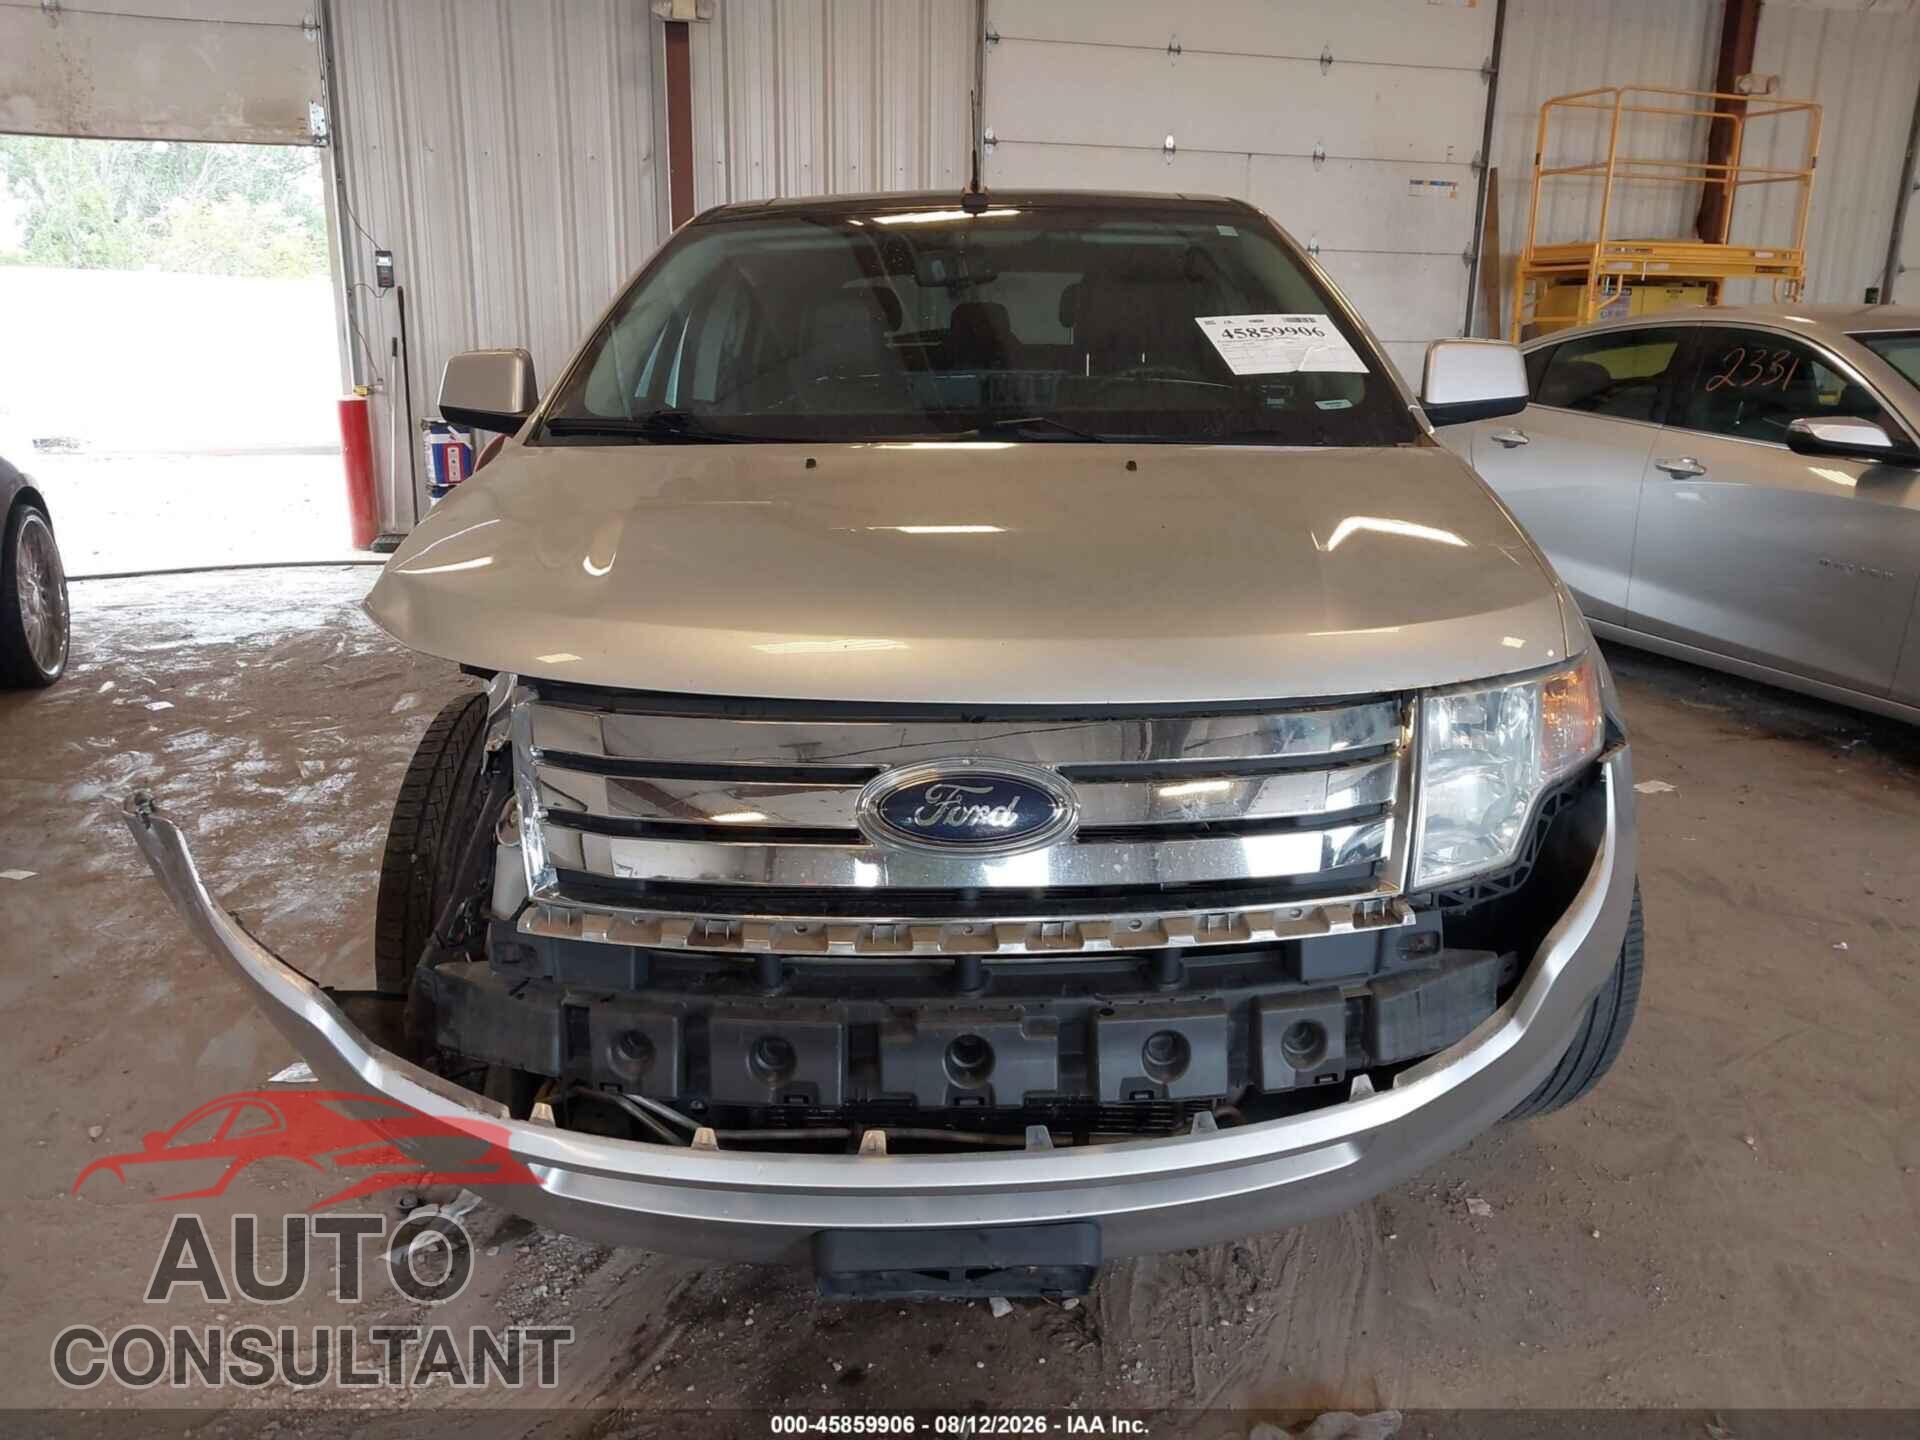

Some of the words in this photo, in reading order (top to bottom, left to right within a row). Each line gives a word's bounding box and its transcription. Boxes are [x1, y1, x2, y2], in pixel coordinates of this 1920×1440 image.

[1222, 326, 1326, 339] 45859906
[1705, 347, 1799, 392] 2331
[914, 783, 1021, 828] Ford
